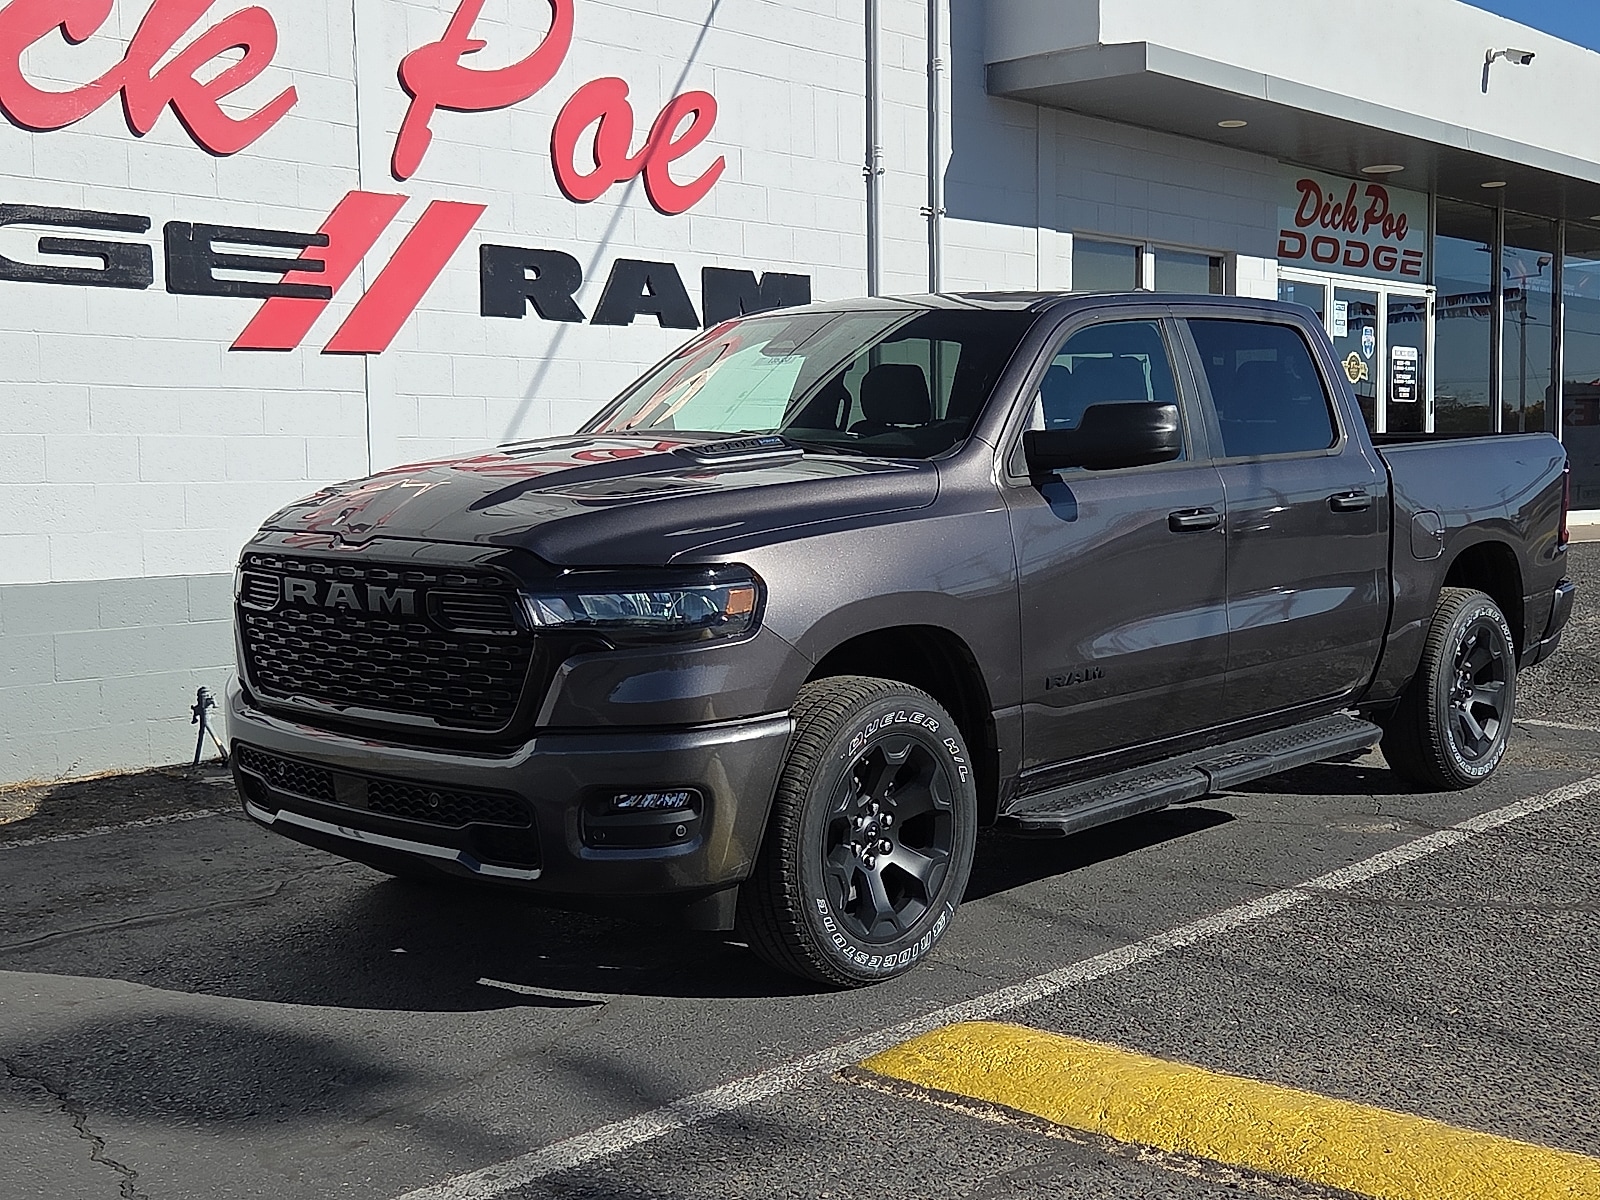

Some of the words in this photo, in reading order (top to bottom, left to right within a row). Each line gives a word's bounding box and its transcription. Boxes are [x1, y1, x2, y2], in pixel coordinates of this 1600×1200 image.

[391, 0, 726, 216] Poe
[1295, 178, 1359, 233] Dick
[1362, 184, 1408, 241] Poe
[1277, 229, 1424, 277] DODGE
[479, 243, 811, 331] RAM
[283, 576, 417, 615] RAM
[1045, 666, 1106, 691] RAM
[848, 710, 940, 756] DUELER
[816, 898, 947, 968] BRIDGESTONE
